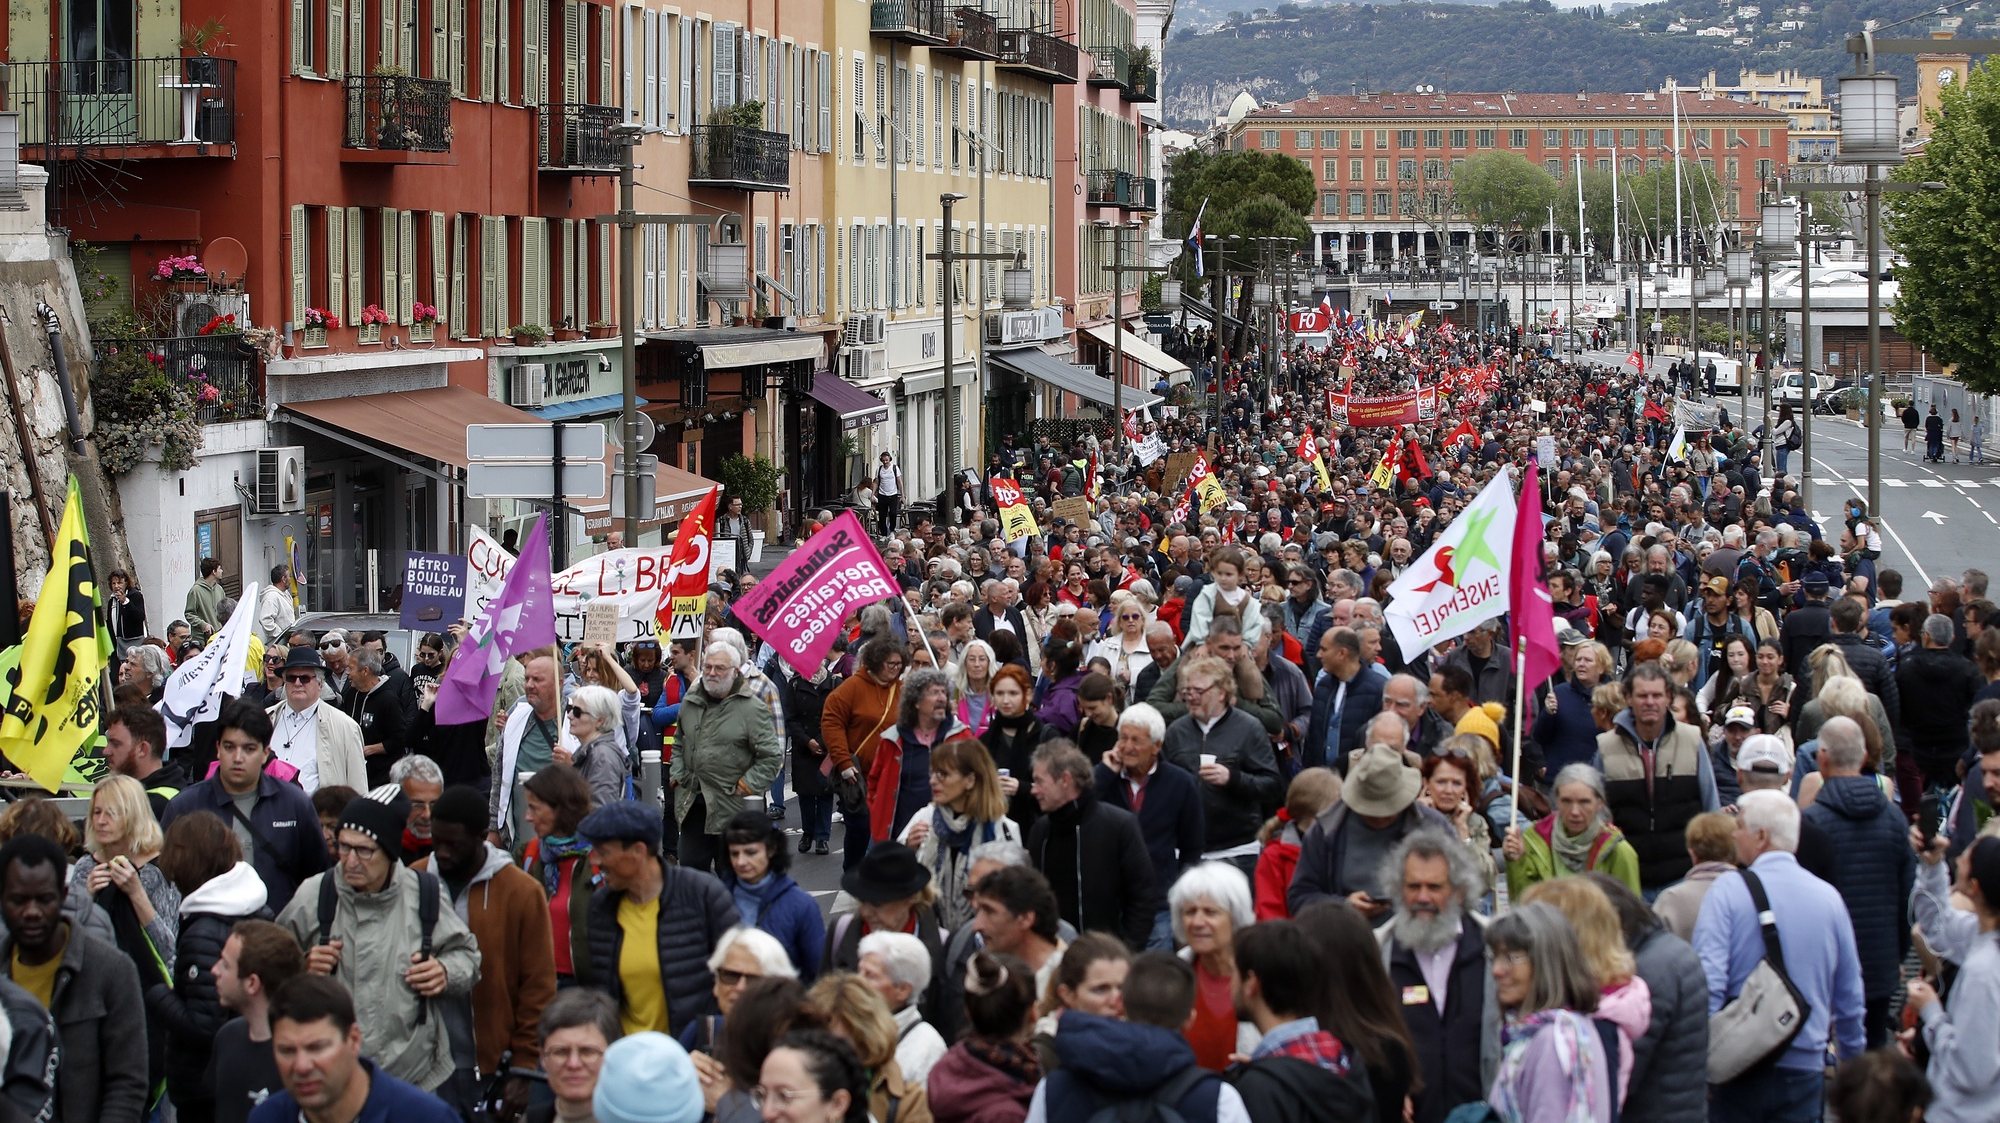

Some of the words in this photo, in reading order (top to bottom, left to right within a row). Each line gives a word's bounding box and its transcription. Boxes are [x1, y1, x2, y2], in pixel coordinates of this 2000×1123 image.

[1298, 312, 1316, 329] FO
[1419, 397, 1435, 408] cgt
[408, 556, 449, 572] MÉTRO
[407, 570, 457, 585] BOULOT
[407, 582, 463, 598] TOMBEAU
